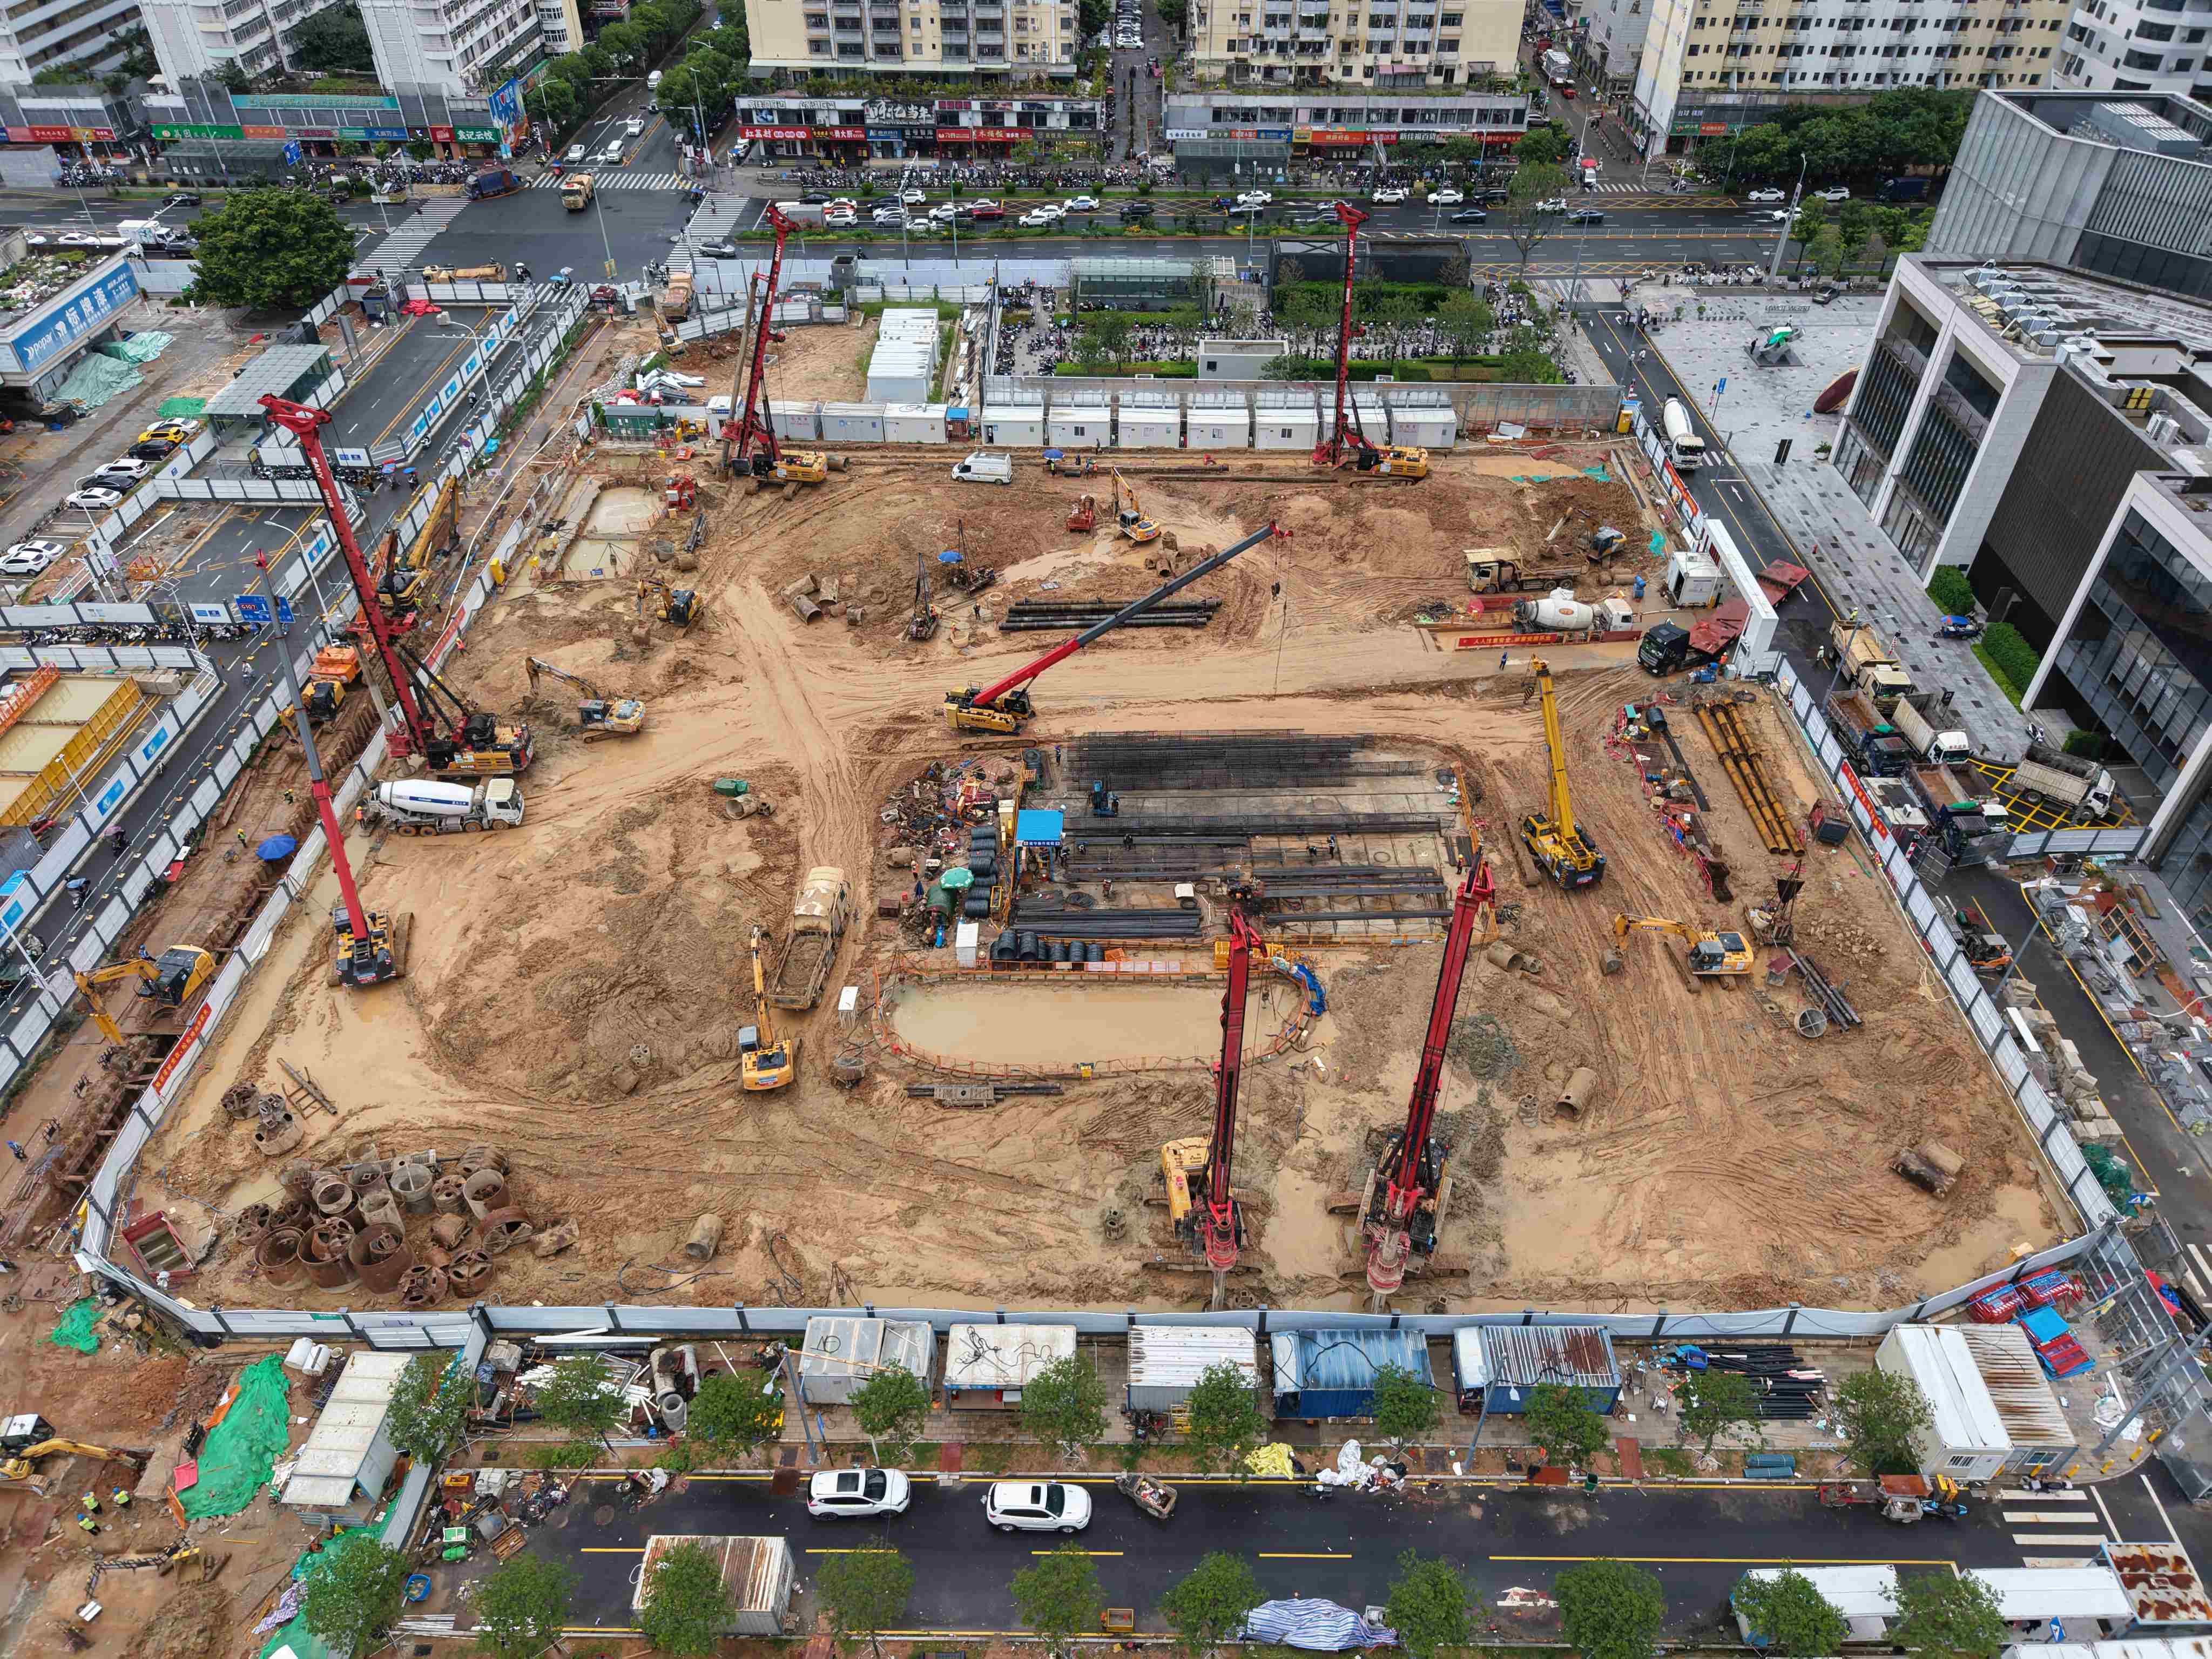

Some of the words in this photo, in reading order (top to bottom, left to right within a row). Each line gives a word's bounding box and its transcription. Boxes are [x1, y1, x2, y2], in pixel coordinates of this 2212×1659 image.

[458, 130, 495, 140] 袁记云饺
[311, 457, 325, 480] SANY
